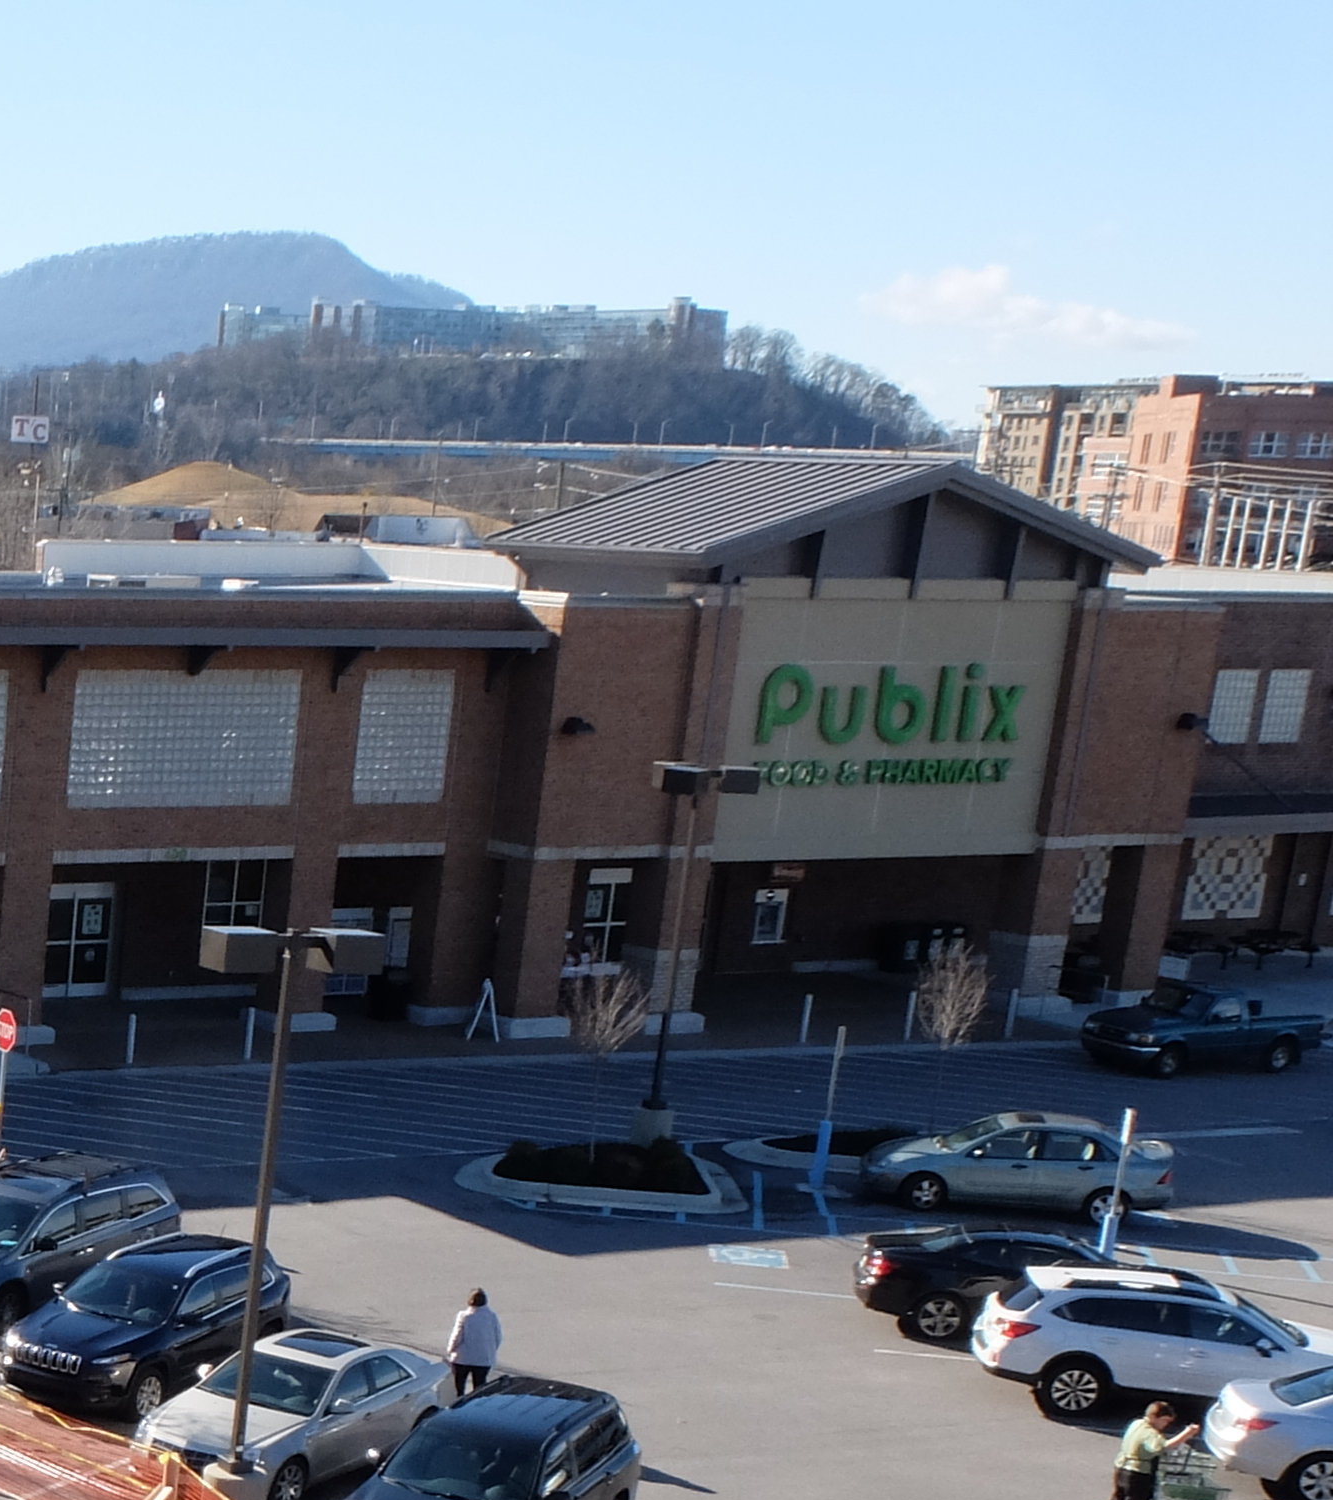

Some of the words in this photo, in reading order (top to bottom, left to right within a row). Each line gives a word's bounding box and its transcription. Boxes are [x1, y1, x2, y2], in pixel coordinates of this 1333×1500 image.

[754, 663, 1025, 744] Publix
[835, 759, 859, 786] &
[865, 757, 1011, 784] PHARMACY
